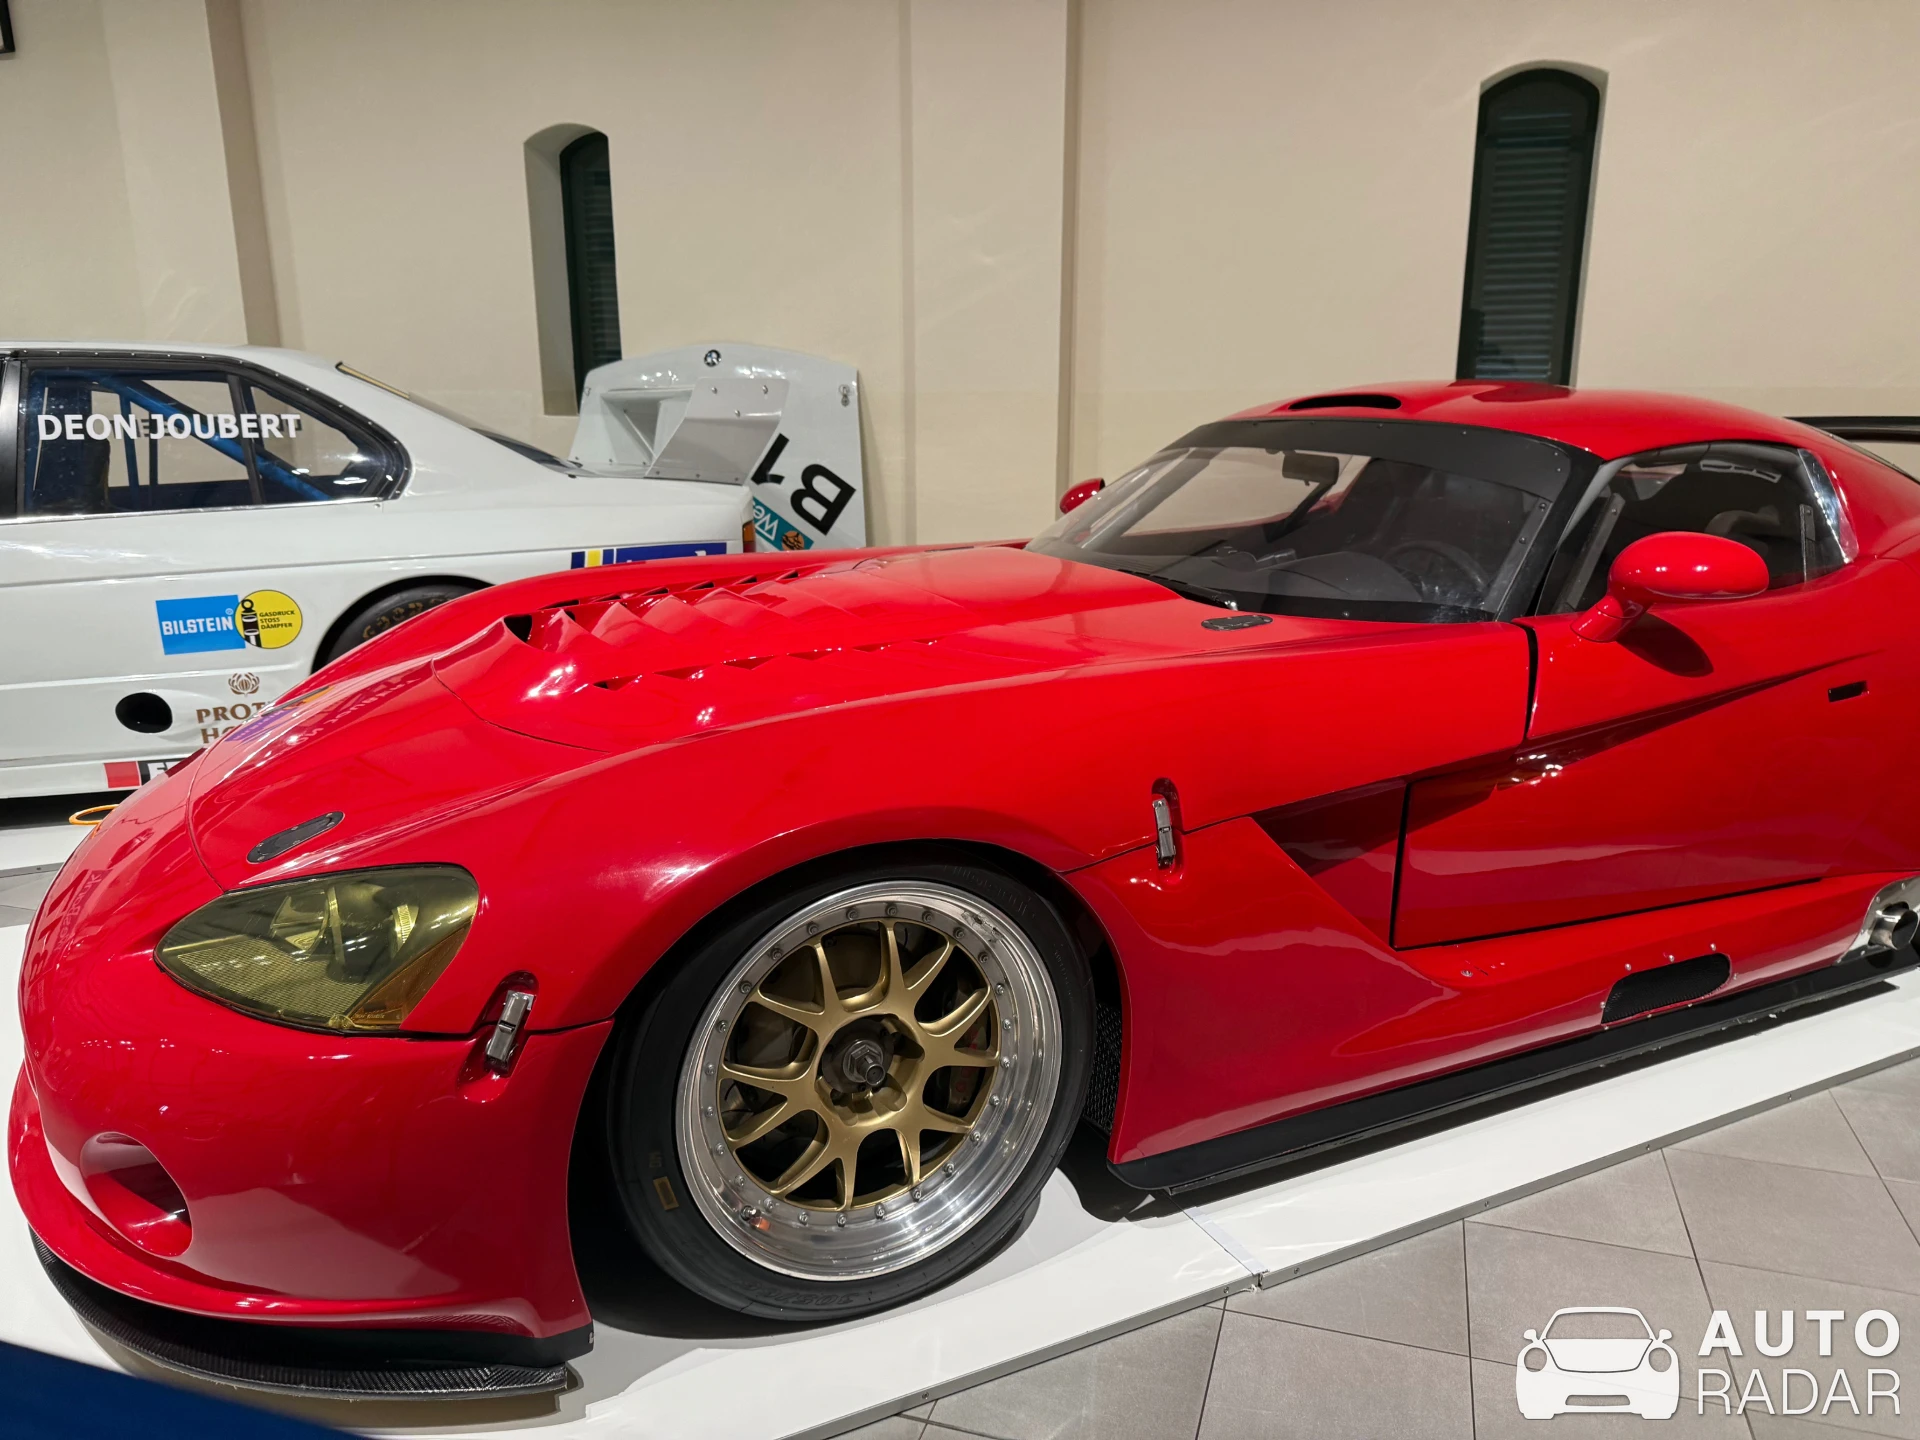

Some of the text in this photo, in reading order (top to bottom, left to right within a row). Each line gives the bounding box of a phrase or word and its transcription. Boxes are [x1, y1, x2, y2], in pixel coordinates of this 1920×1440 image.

[37, 413, 300, 440] DEON JOUBERT
[752, 501, 779, 541] We
[161, 615, 234, 636] BILSTEIN
[195, 701, 270, 724] PROT
